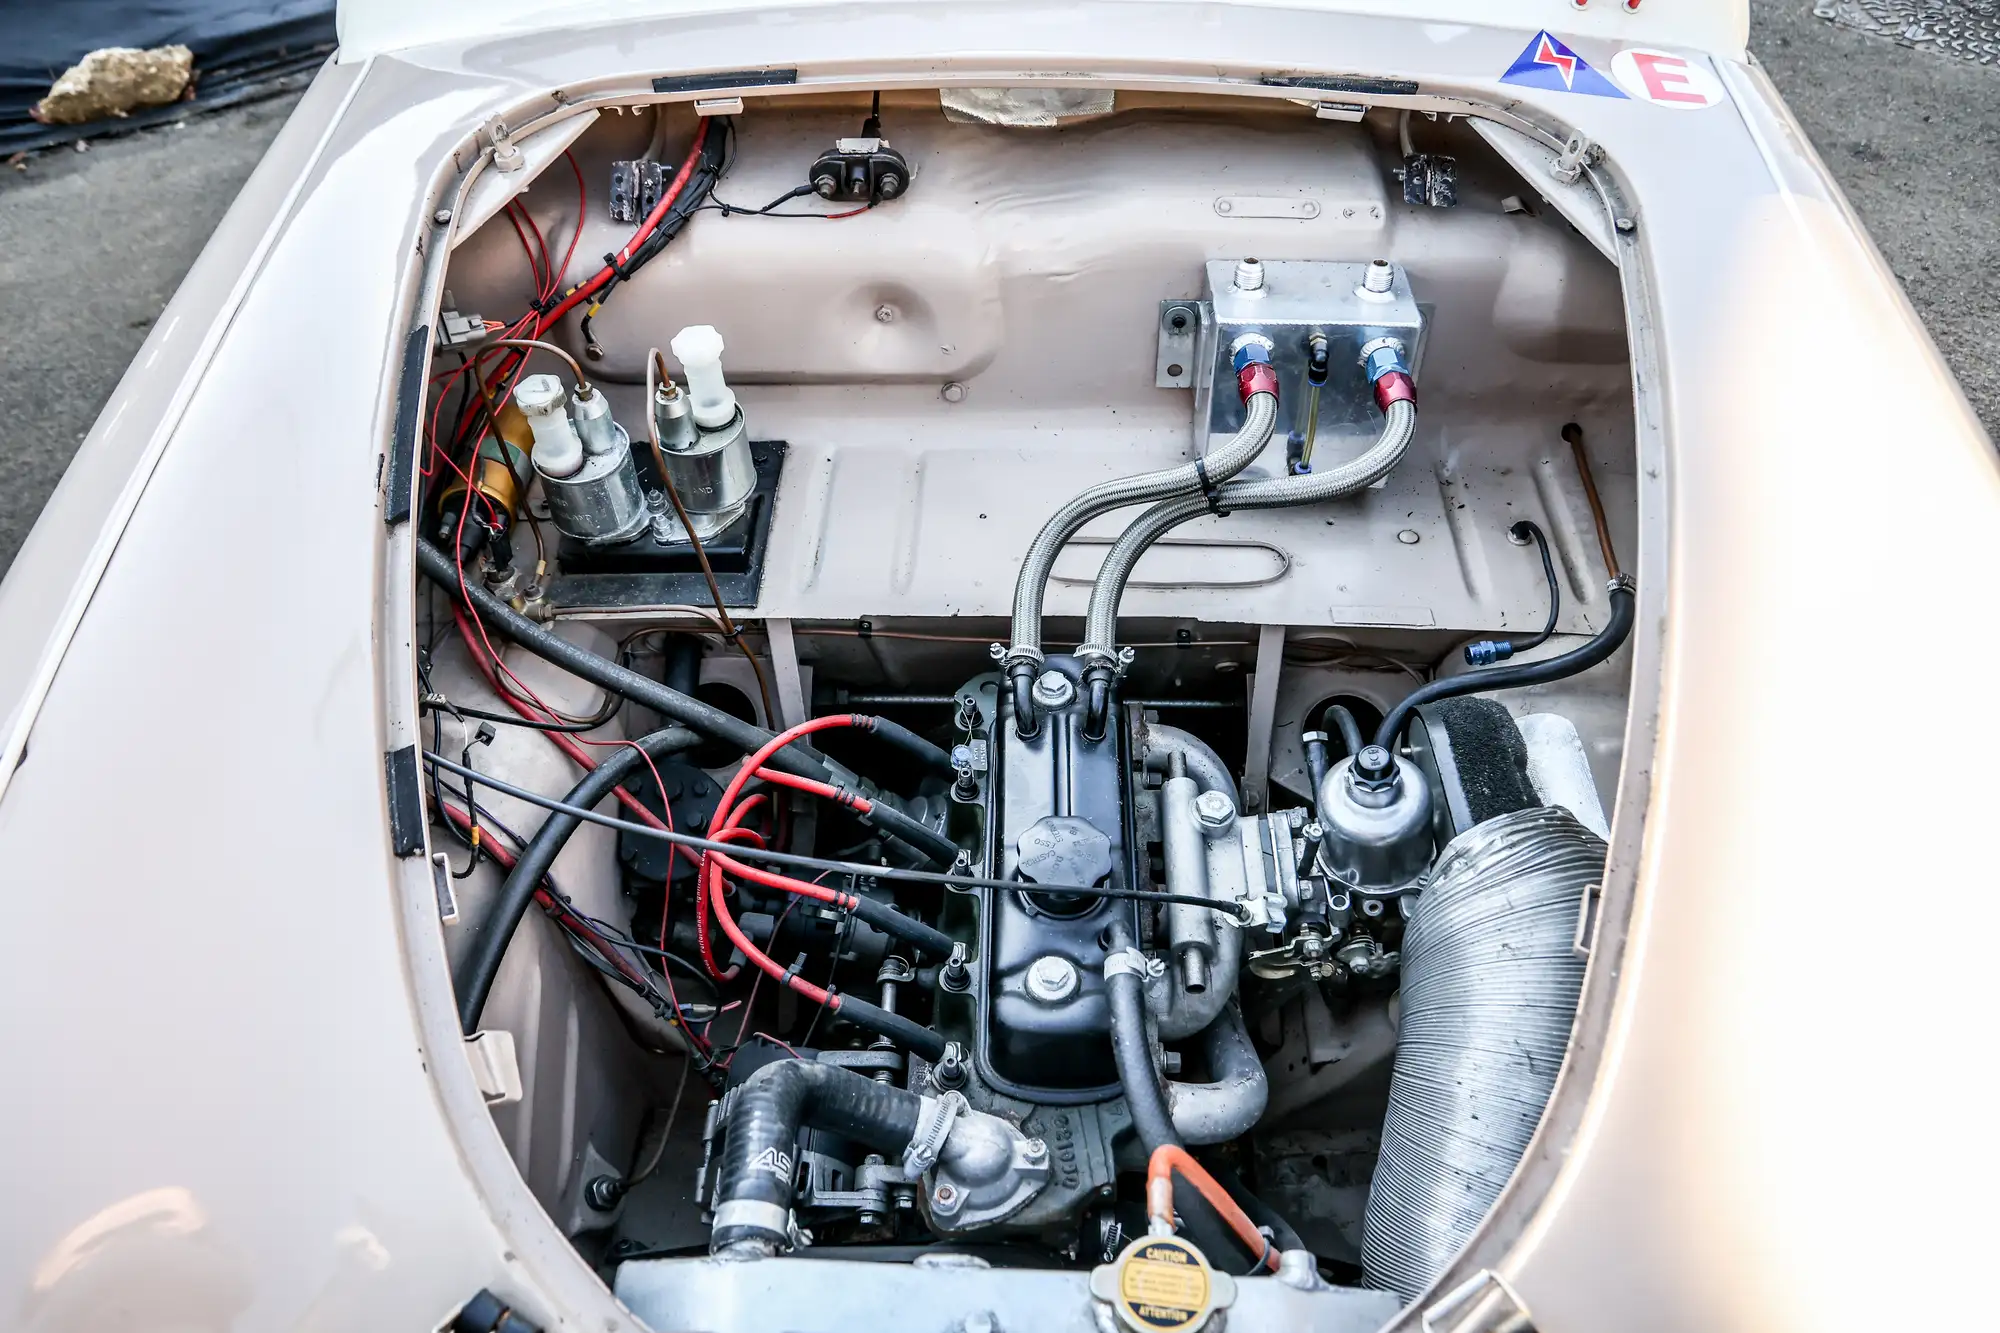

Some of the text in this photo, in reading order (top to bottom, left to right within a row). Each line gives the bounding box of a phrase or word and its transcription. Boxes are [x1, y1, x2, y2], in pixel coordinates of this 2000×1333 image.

[1632, 52, 1708, 105] E
[527, 625, 546, 641] SAE
[1034, 838, 1056, 849] ESSO
[1022, 850, 1056, 868] CASTROL
[1146, 1247, 1188, 1264] CAUTION
[1138, 1304, 1189, 1322] ATTENTION
